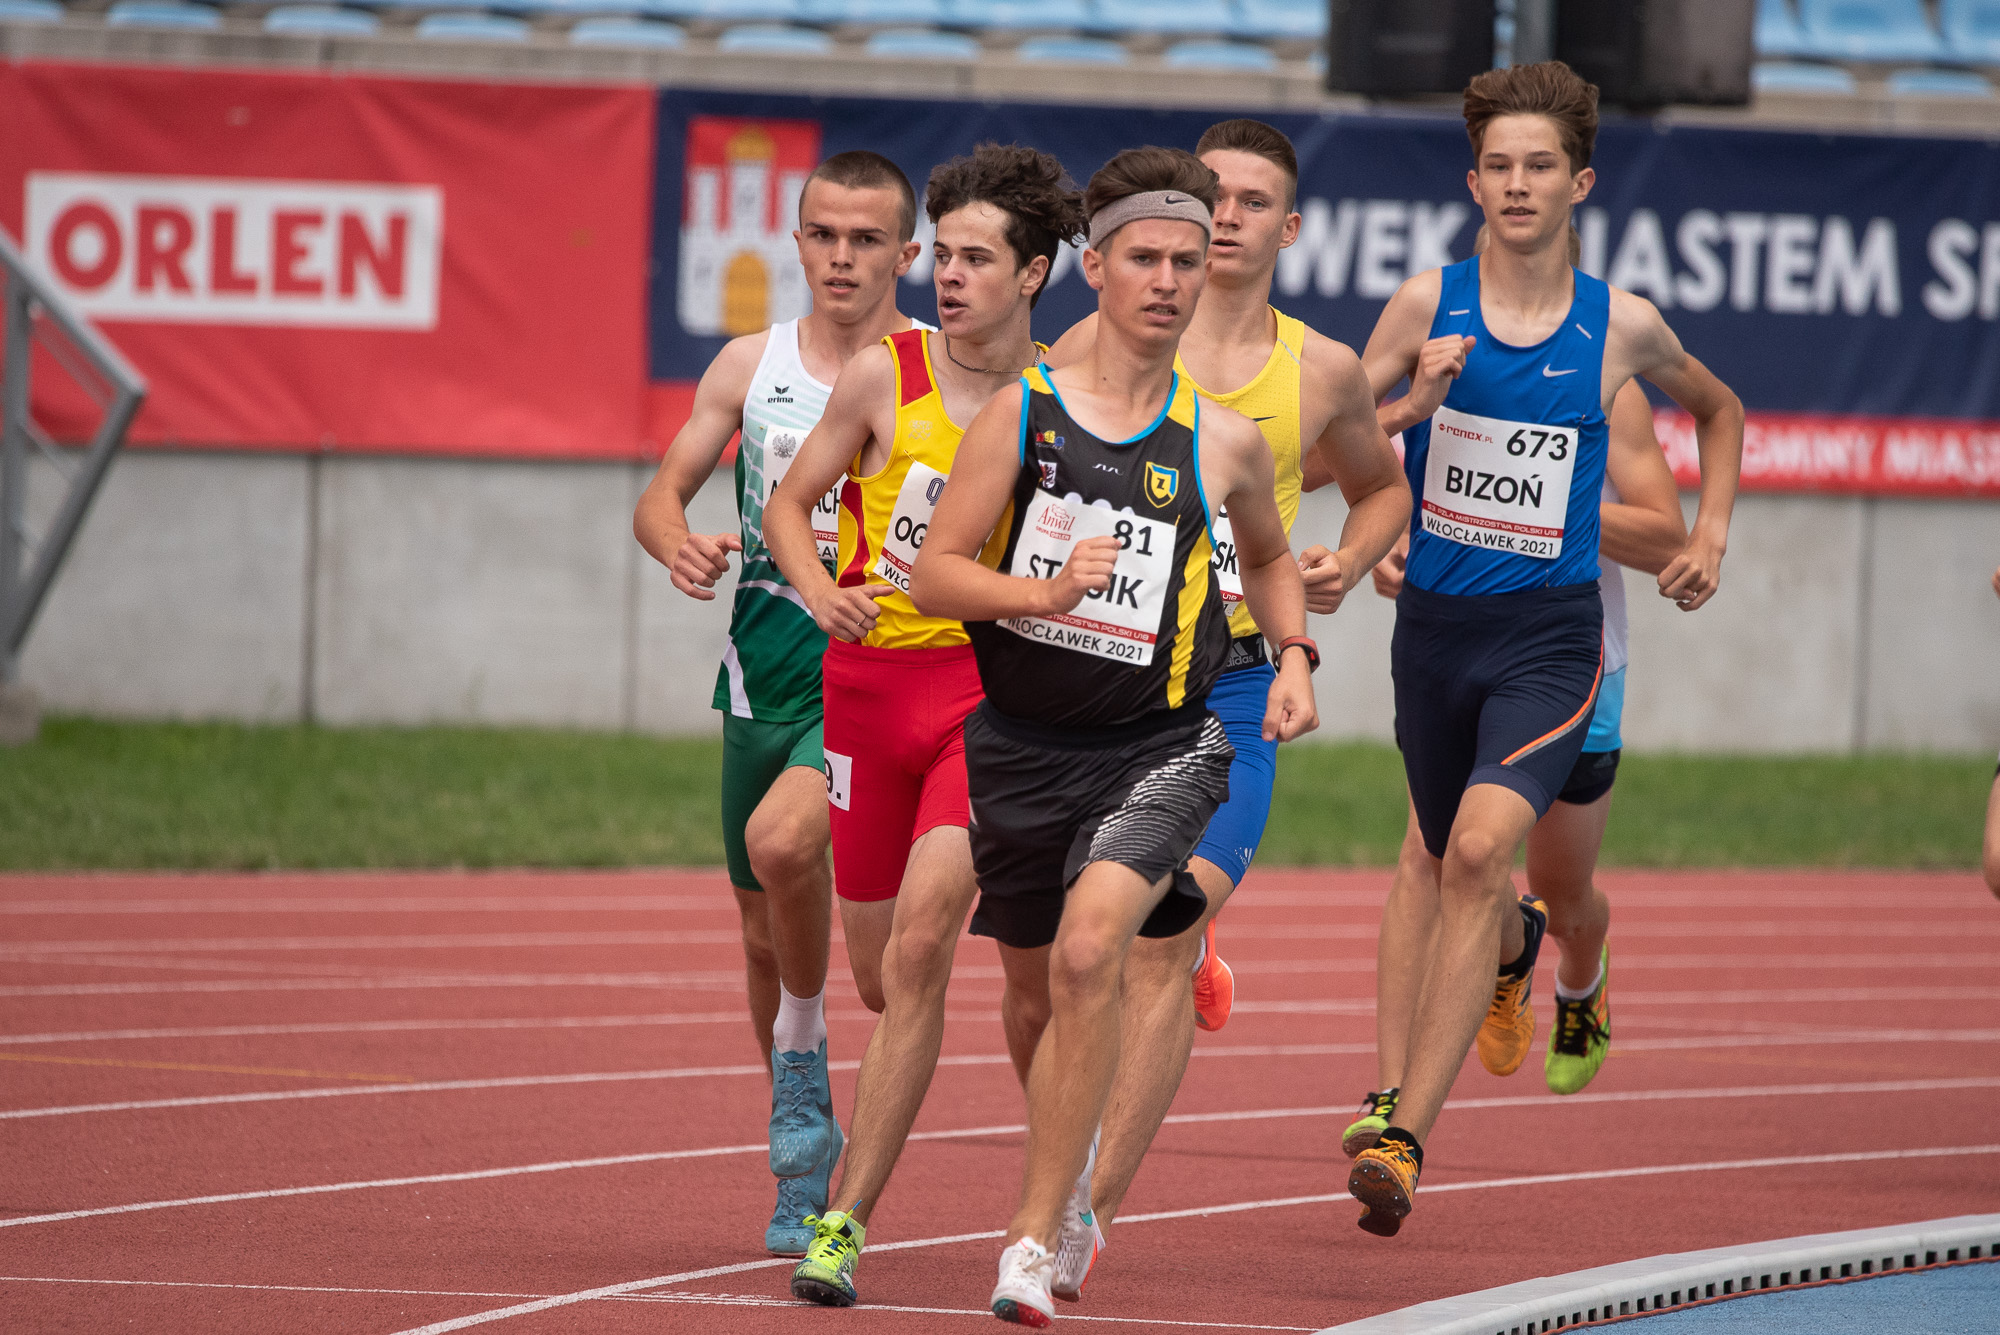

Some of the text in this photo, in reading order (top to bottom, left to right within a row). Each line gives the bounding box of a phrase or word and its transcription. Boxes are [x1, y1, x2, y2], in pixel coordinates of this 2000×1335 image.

[48, 198, 408, 300] ORLEN
[1572, 204, 1903, 318] IASTEM
[767, 396, 794, 404] erima
[1506, 429, 1569, 461] 673
[1445, 464, 1544, 508] BIZOŃ
[1038, 505, 1076, 531] Anwil
[1454, 514, 1513, 531] MISTRZOSTWA
[1513, 525, 1543, 535] POLSKI
[1543, 529, 1558, 537] U18
[1112, 520, 1153, 557] 81
[1426, 516, 1555, 556] WŁOCŁAWEK 2021
[1100, 624, 1132, 637] POLSKI
[1133, 632, 1150, 641] U18
[1105, 640, 1144, 661] 2021
